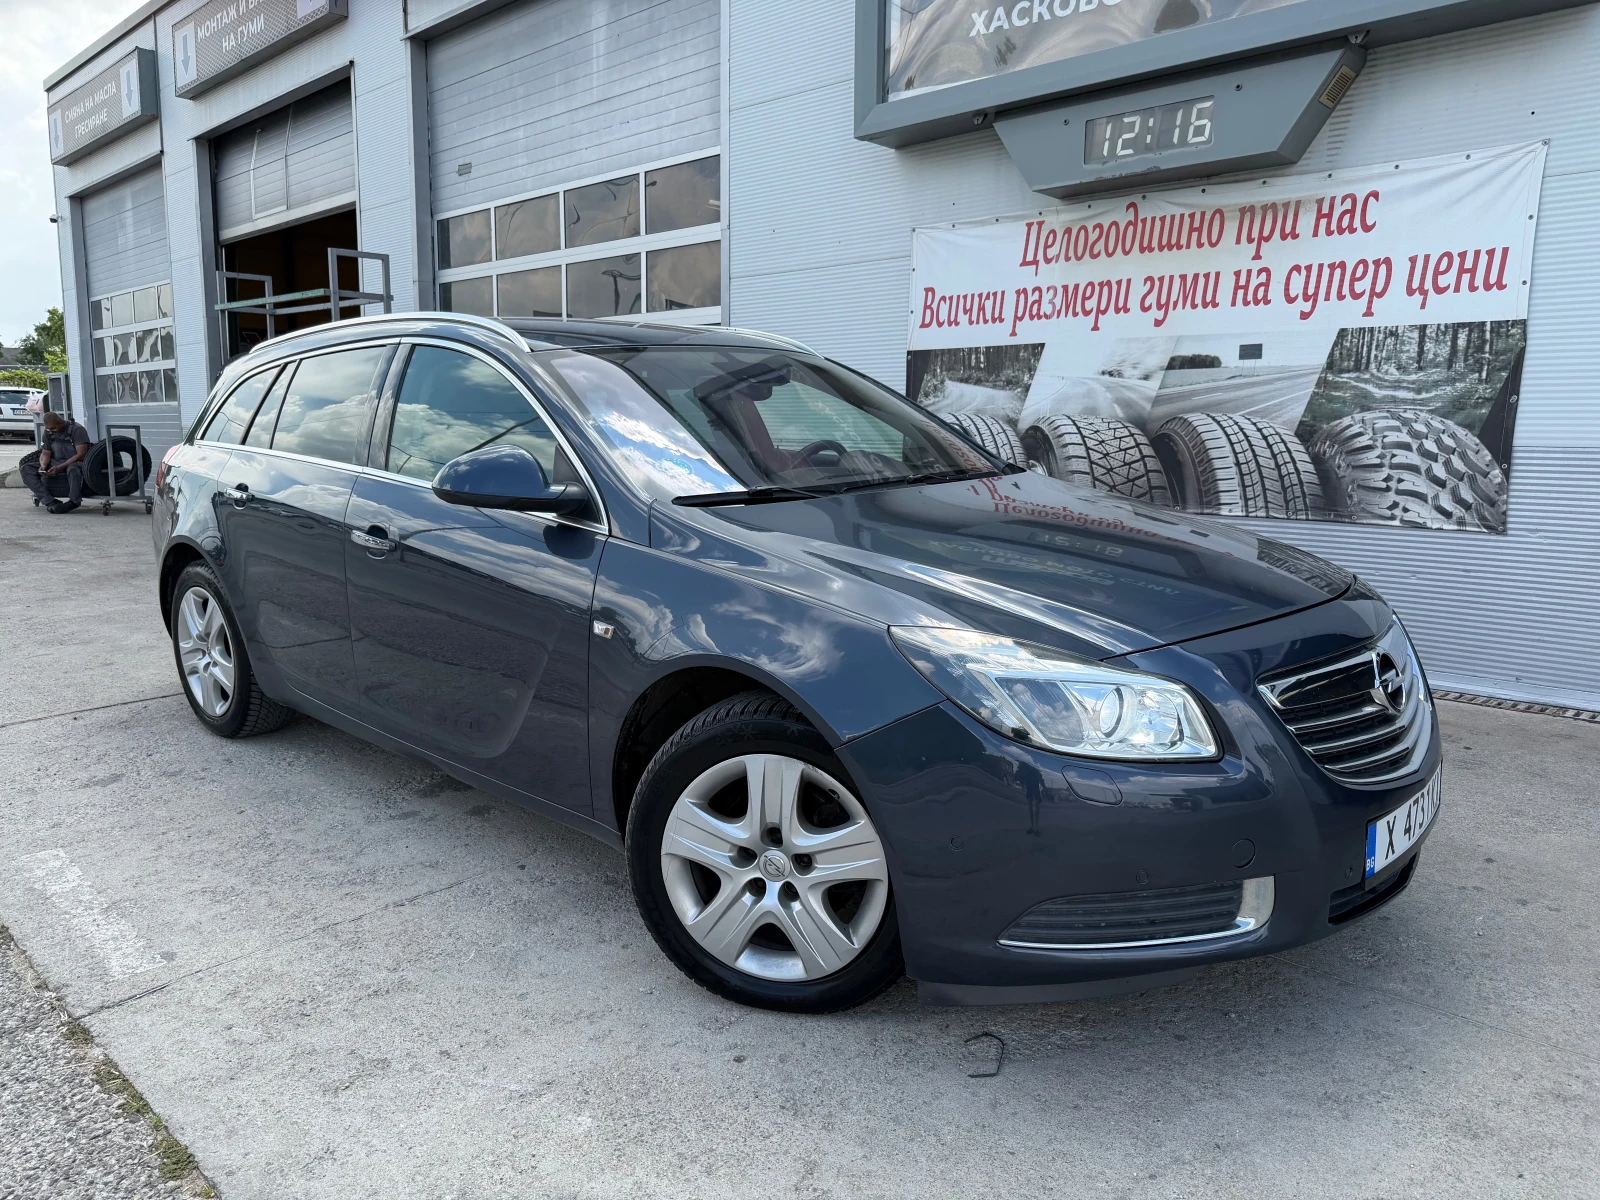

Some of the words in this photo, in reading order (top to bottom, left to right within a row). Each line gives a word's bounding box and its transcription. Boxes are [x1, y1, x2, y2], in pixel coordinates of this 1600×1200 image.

[197, 3, 237, 42] МОНТАЖ
[222, 35, 236, 53] НА
[238, 13, 264, 45] ГУМИ
[968, 0, 1122, 37] ХАСКОВ
[85, 95, 94, 111] НА
[1102, 100, 1212, 157] 12:16
[1019, 201, 1225, 276] Целогодишно
[1234, 199, 1302, 261] при
[1312, 189, 1380, 238] нас
[919, 286, 1006, 329] Всички
[1009, 277, 1132, 337] размери
[1139, 270, 1221, 327] гуми
[1230, 266, 1272, 307] на
[1283, 255, 1393, 320] супер
[1405, 246, 1510, 310] цени
[1366, 855, 1375, 872] BG
